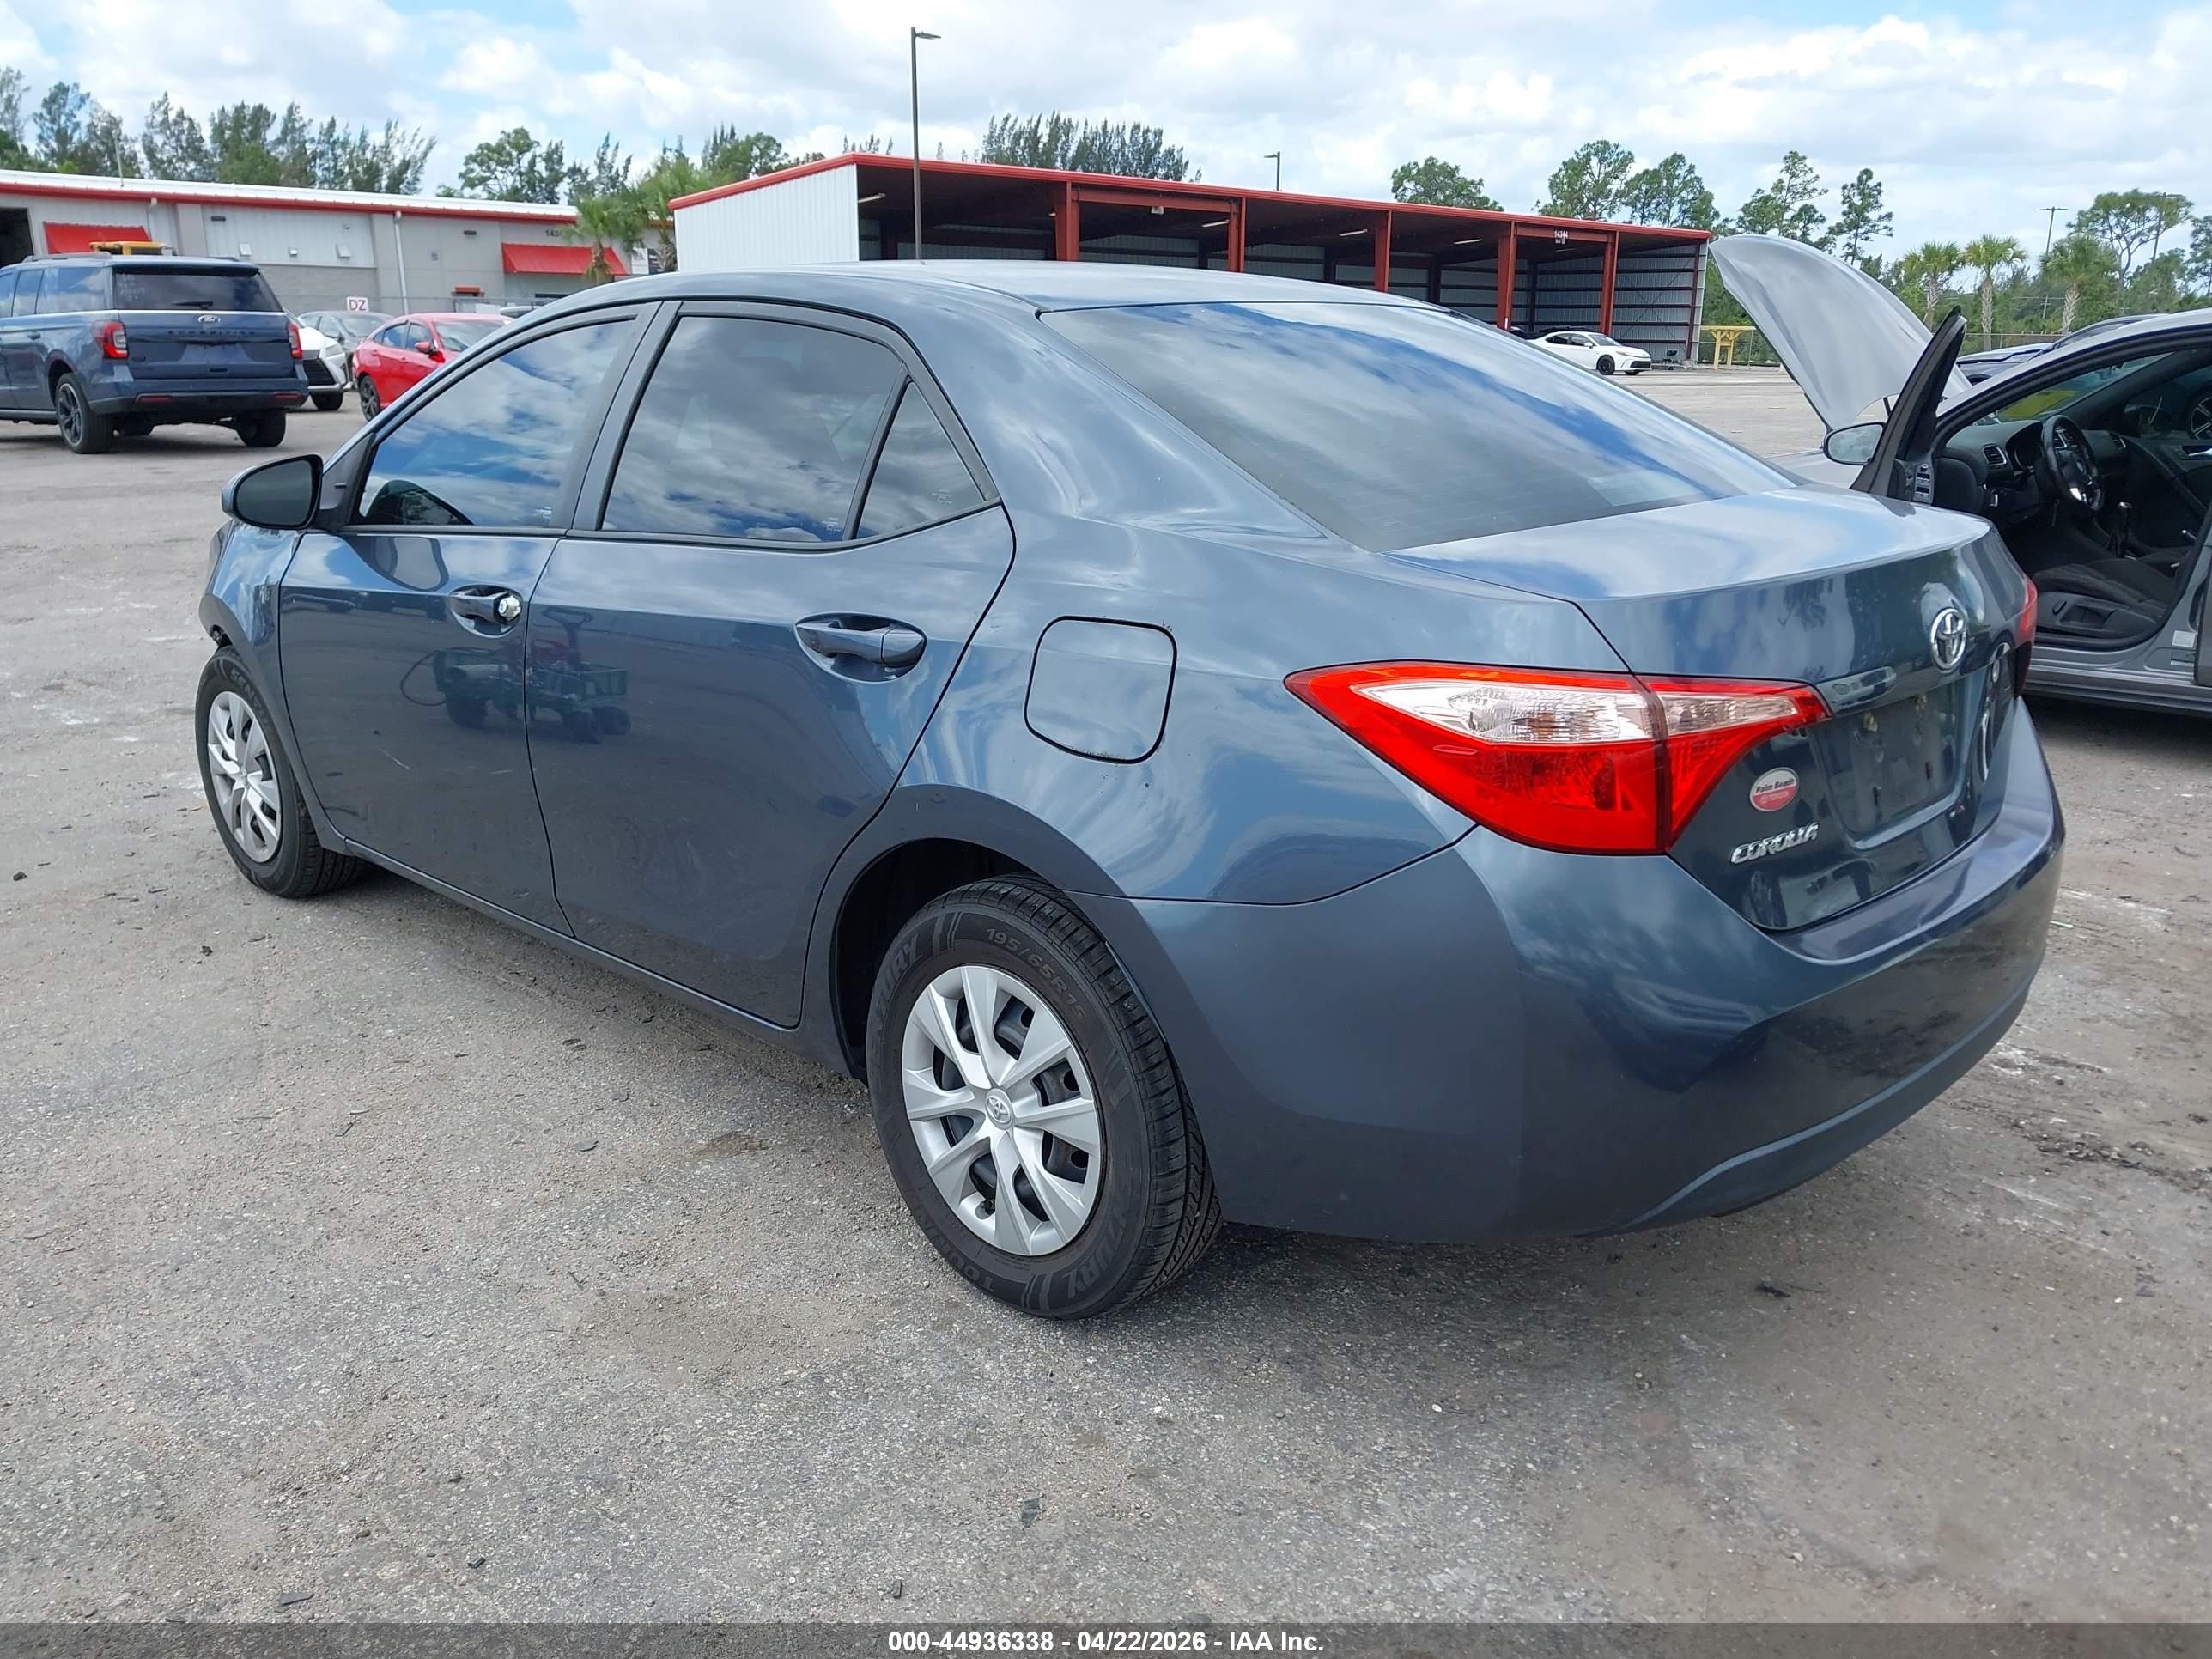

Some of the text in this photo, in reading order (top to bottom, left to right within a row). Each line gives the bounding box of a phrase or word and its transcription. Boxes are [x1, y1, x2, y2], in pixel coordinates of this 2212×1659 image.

[349, 300, 367, 311] DZ
[1755, 784, 1773, 793] Palm
[1730, 822, 1820, 864] COROLLA
[985, 928, 1085, 1018] 195/65R15
